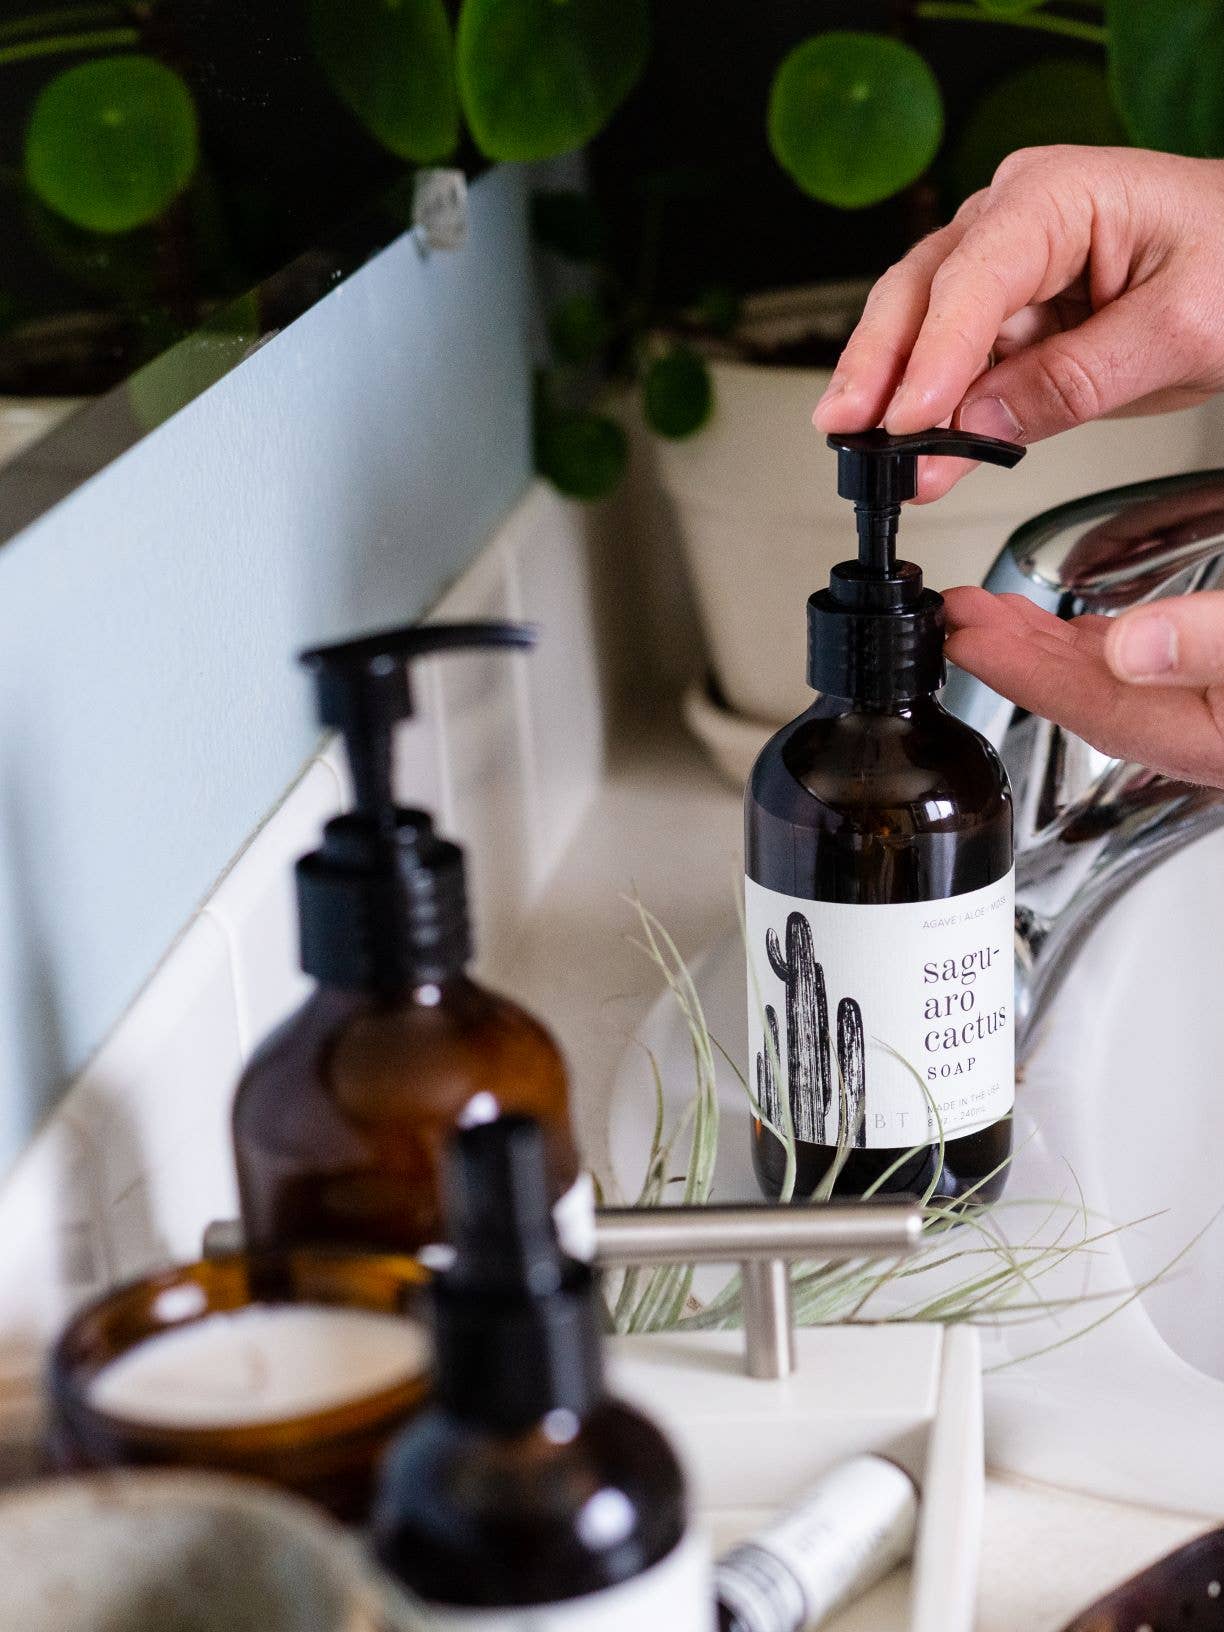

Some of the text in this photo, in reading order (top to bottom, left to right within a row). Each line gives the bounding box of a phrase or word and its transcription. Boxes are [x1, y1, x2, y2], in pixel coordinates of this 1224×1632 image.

[924, 947, 1000, 985] sagu-
[924, 990, 975, 1020] aro
[925, 1006, 1006, 1052] cactus
[927, 1057, 976, 1080] SOAP
